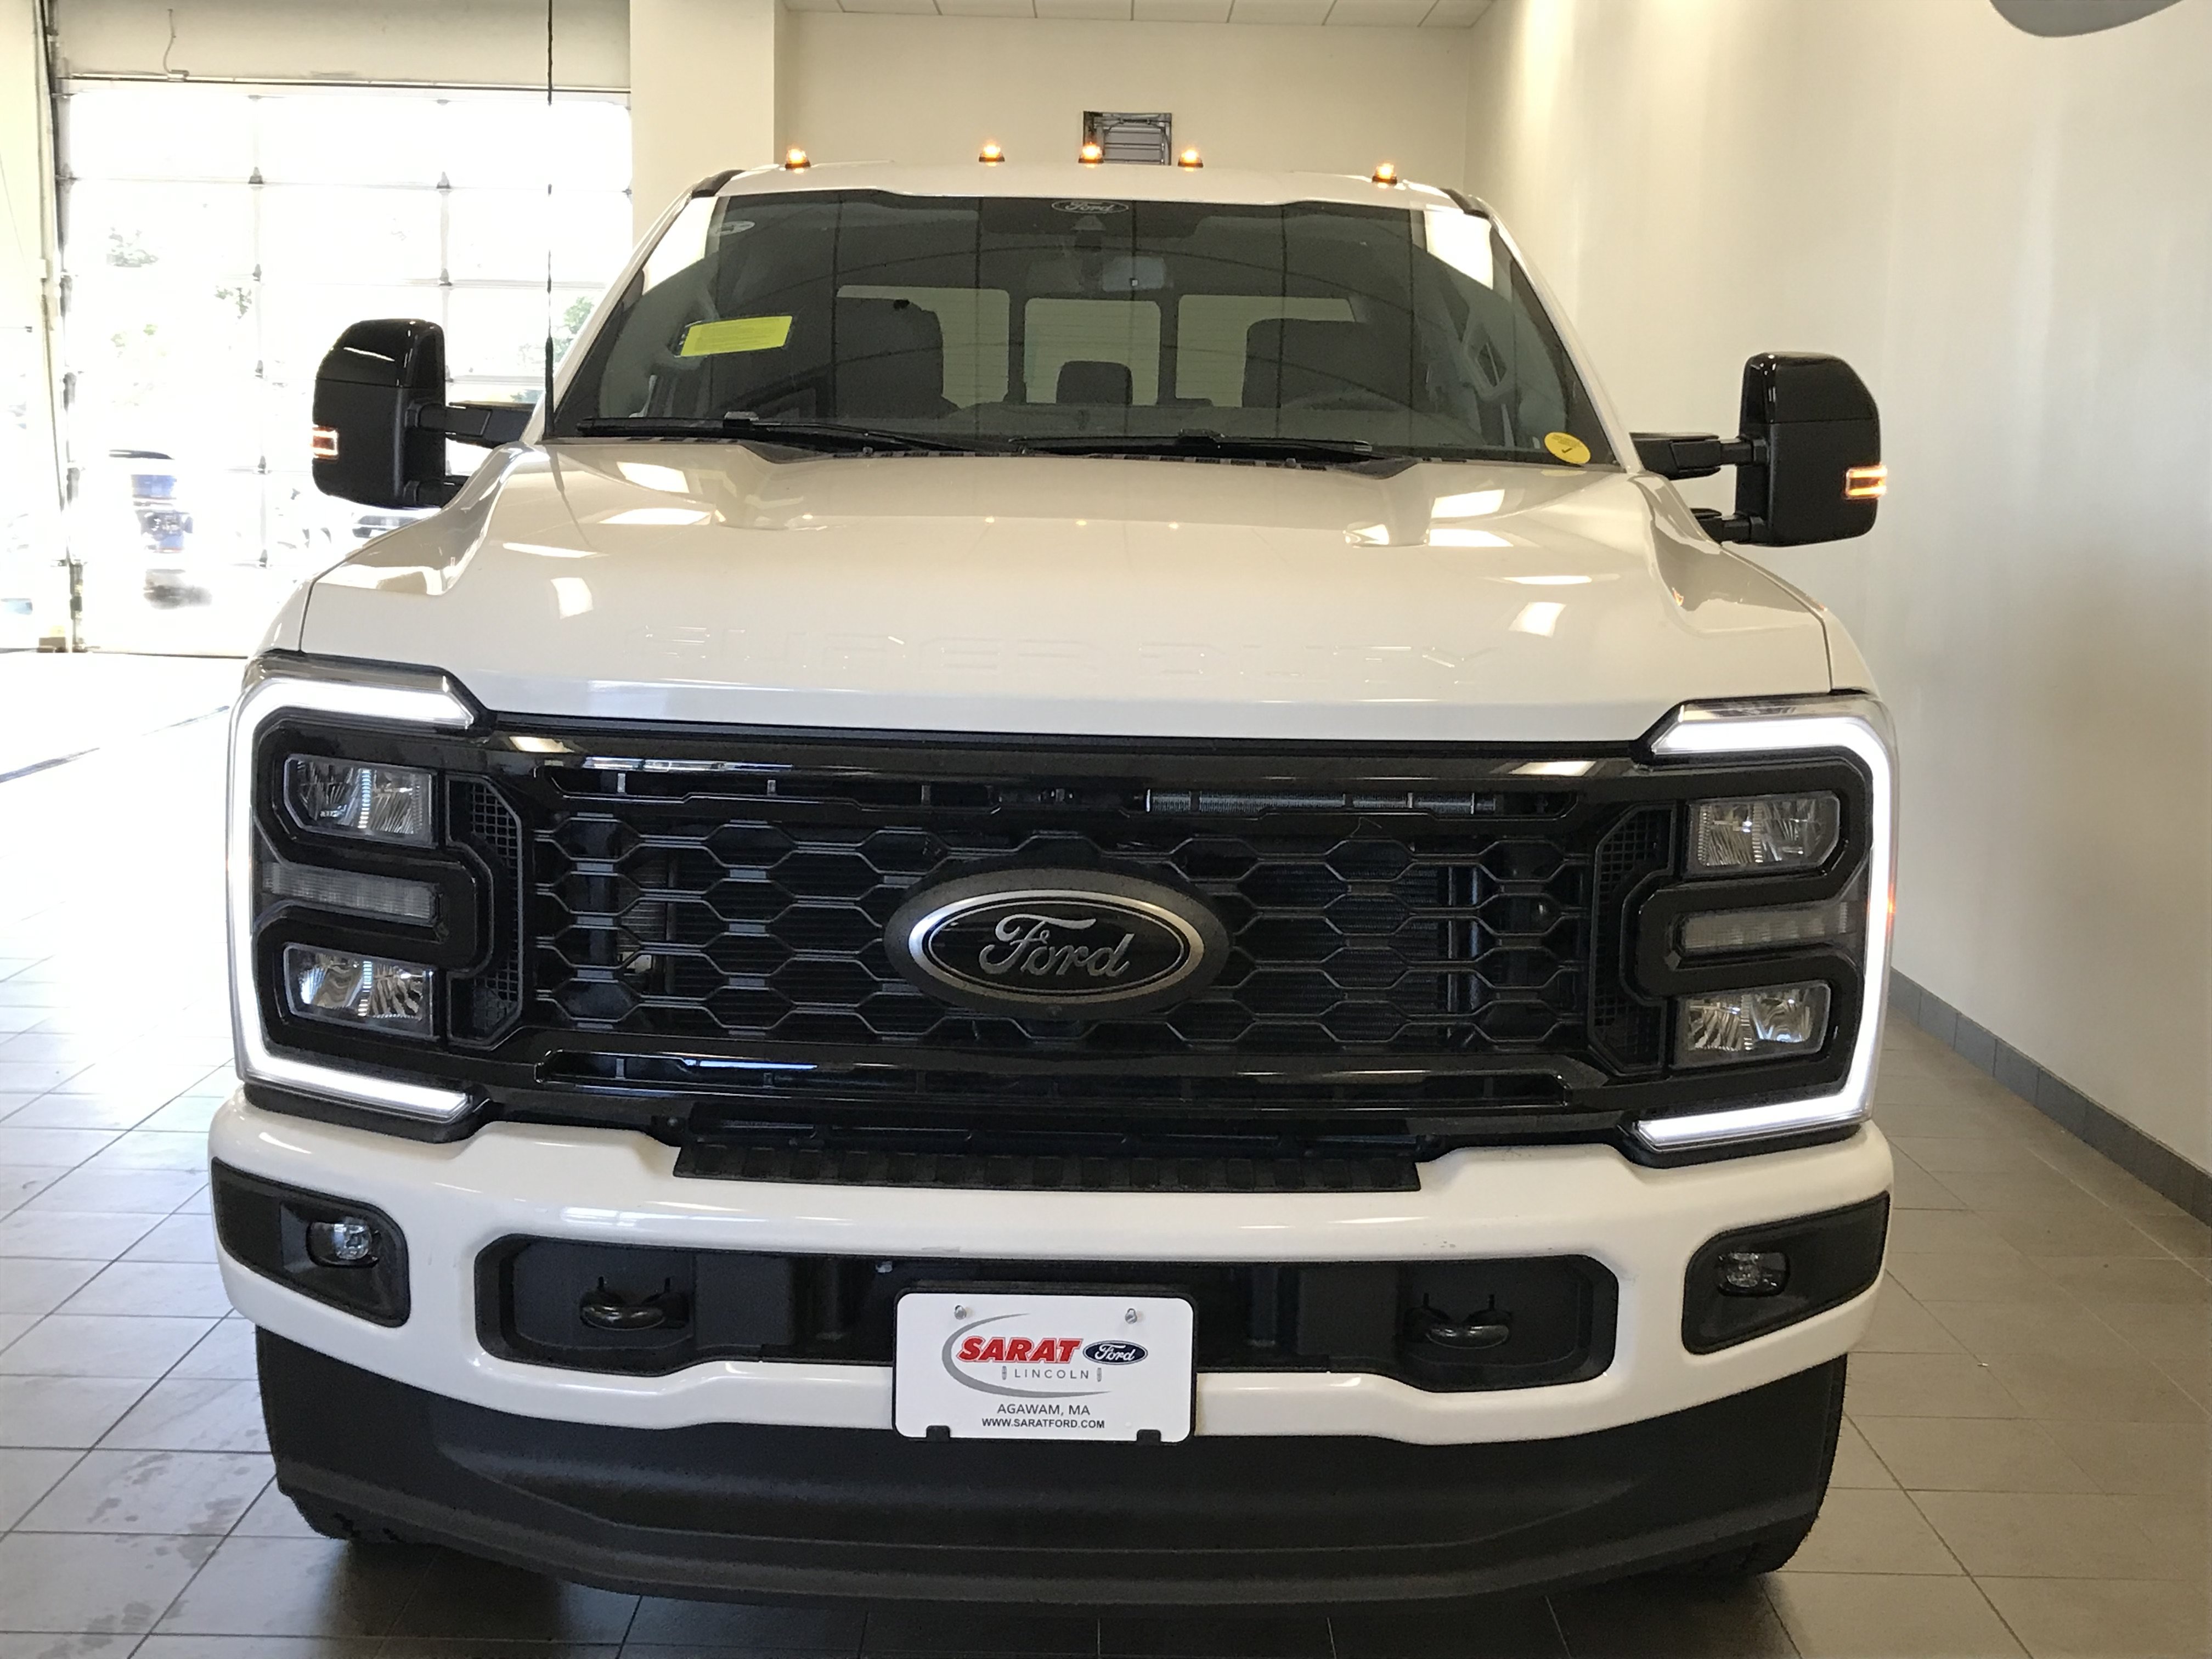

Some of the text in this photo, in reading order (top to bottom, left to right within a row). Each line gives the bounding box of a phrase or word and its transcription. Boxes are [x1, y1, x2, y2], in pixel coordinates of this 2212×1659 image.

[1065, 202, 1114, 212] Ford
[623, 625, 1499, 684] SUPER DUTY
[979, 914, 1135, 977] Ford
[956, 1336, 1135, 1363] SARAT Ford
[1015, 1369, 1088, 1379] LINCOLN
[997, 1404, 1090, 1415] AGAWAM, MA
[982, 1418, 1105, 1429] WWW.SARATFORD.COM
